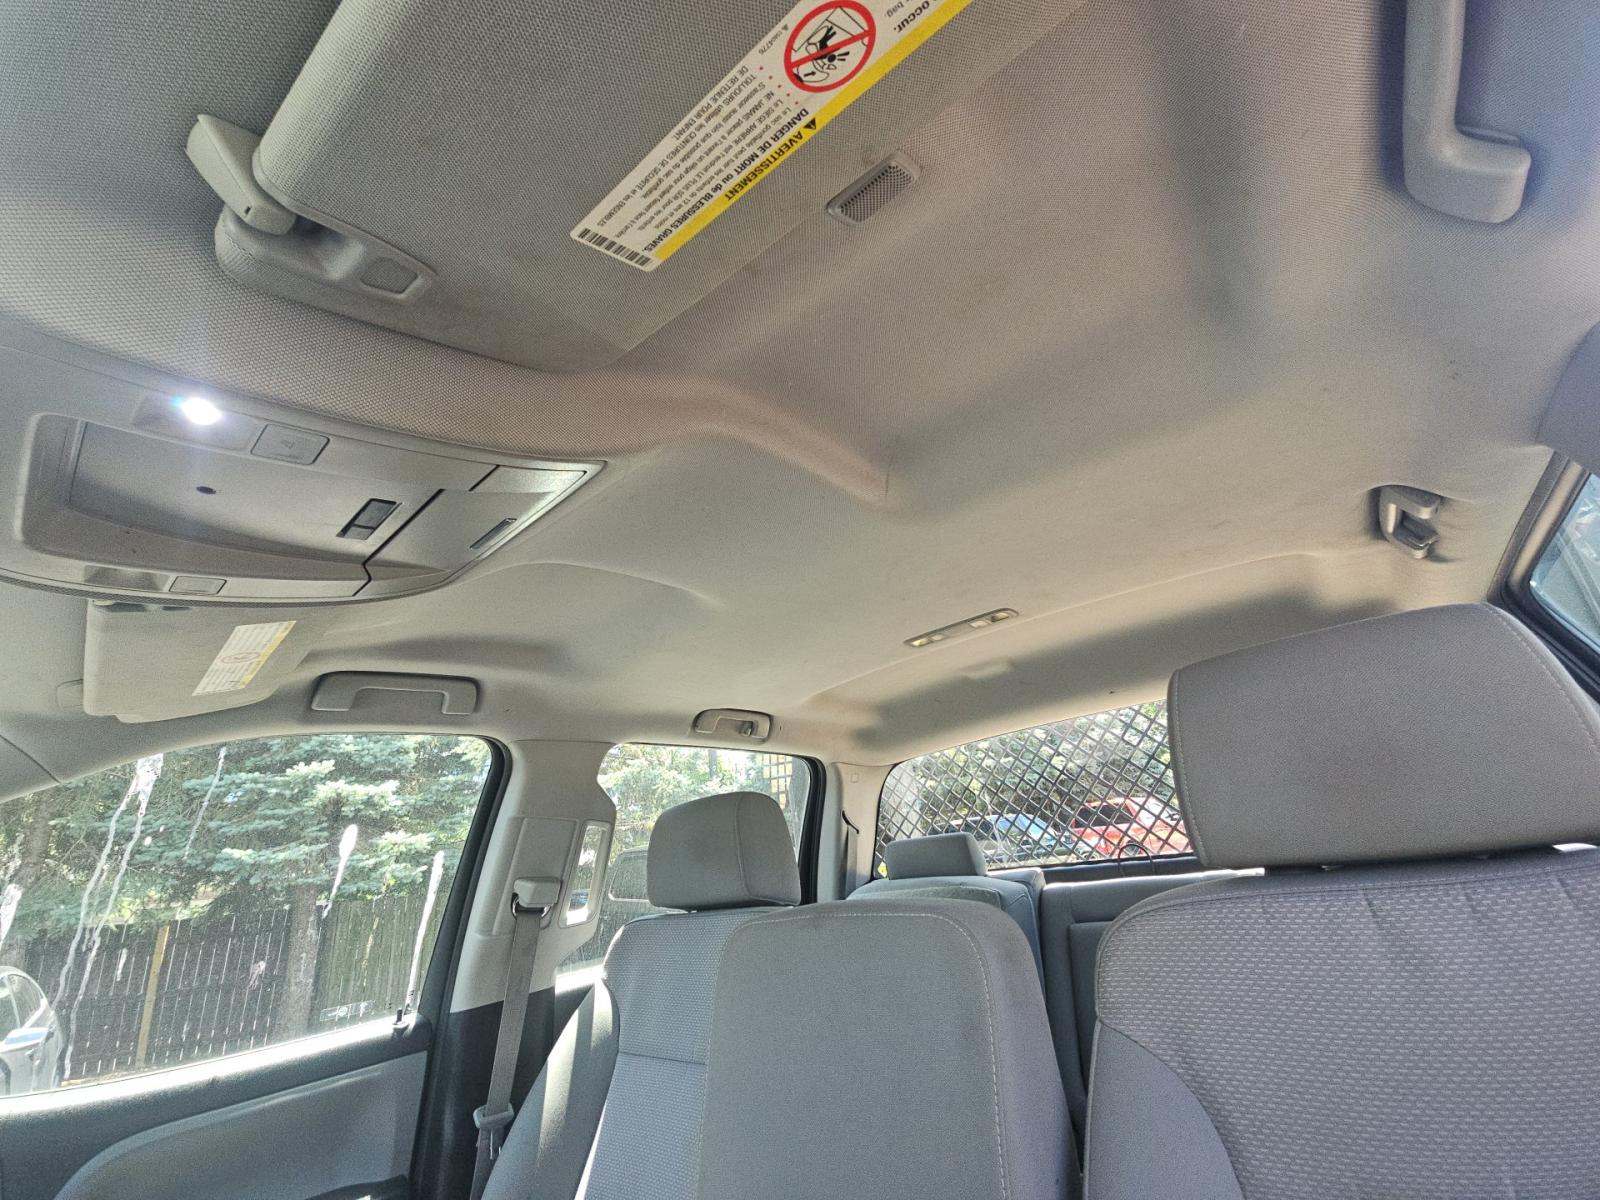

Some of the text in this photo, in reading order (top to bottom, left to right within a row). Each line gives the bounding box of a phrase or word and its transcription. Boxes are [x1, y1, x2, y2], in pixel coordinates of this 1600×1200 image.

[893, 0, 930, 33] occur.
[693, 101, 712, 120] POUR
[769, 107, 809, 142] DANGER
[756, 140, 772, 153] DE
[722, 130, 804, 201] AVERTISSEMENT
[732, 151, 760, 175] MORT
[709, 182, 724, 194] de
[720, 172, 734, 184] ou
[669, 191, 714, 229] BLESSURES
